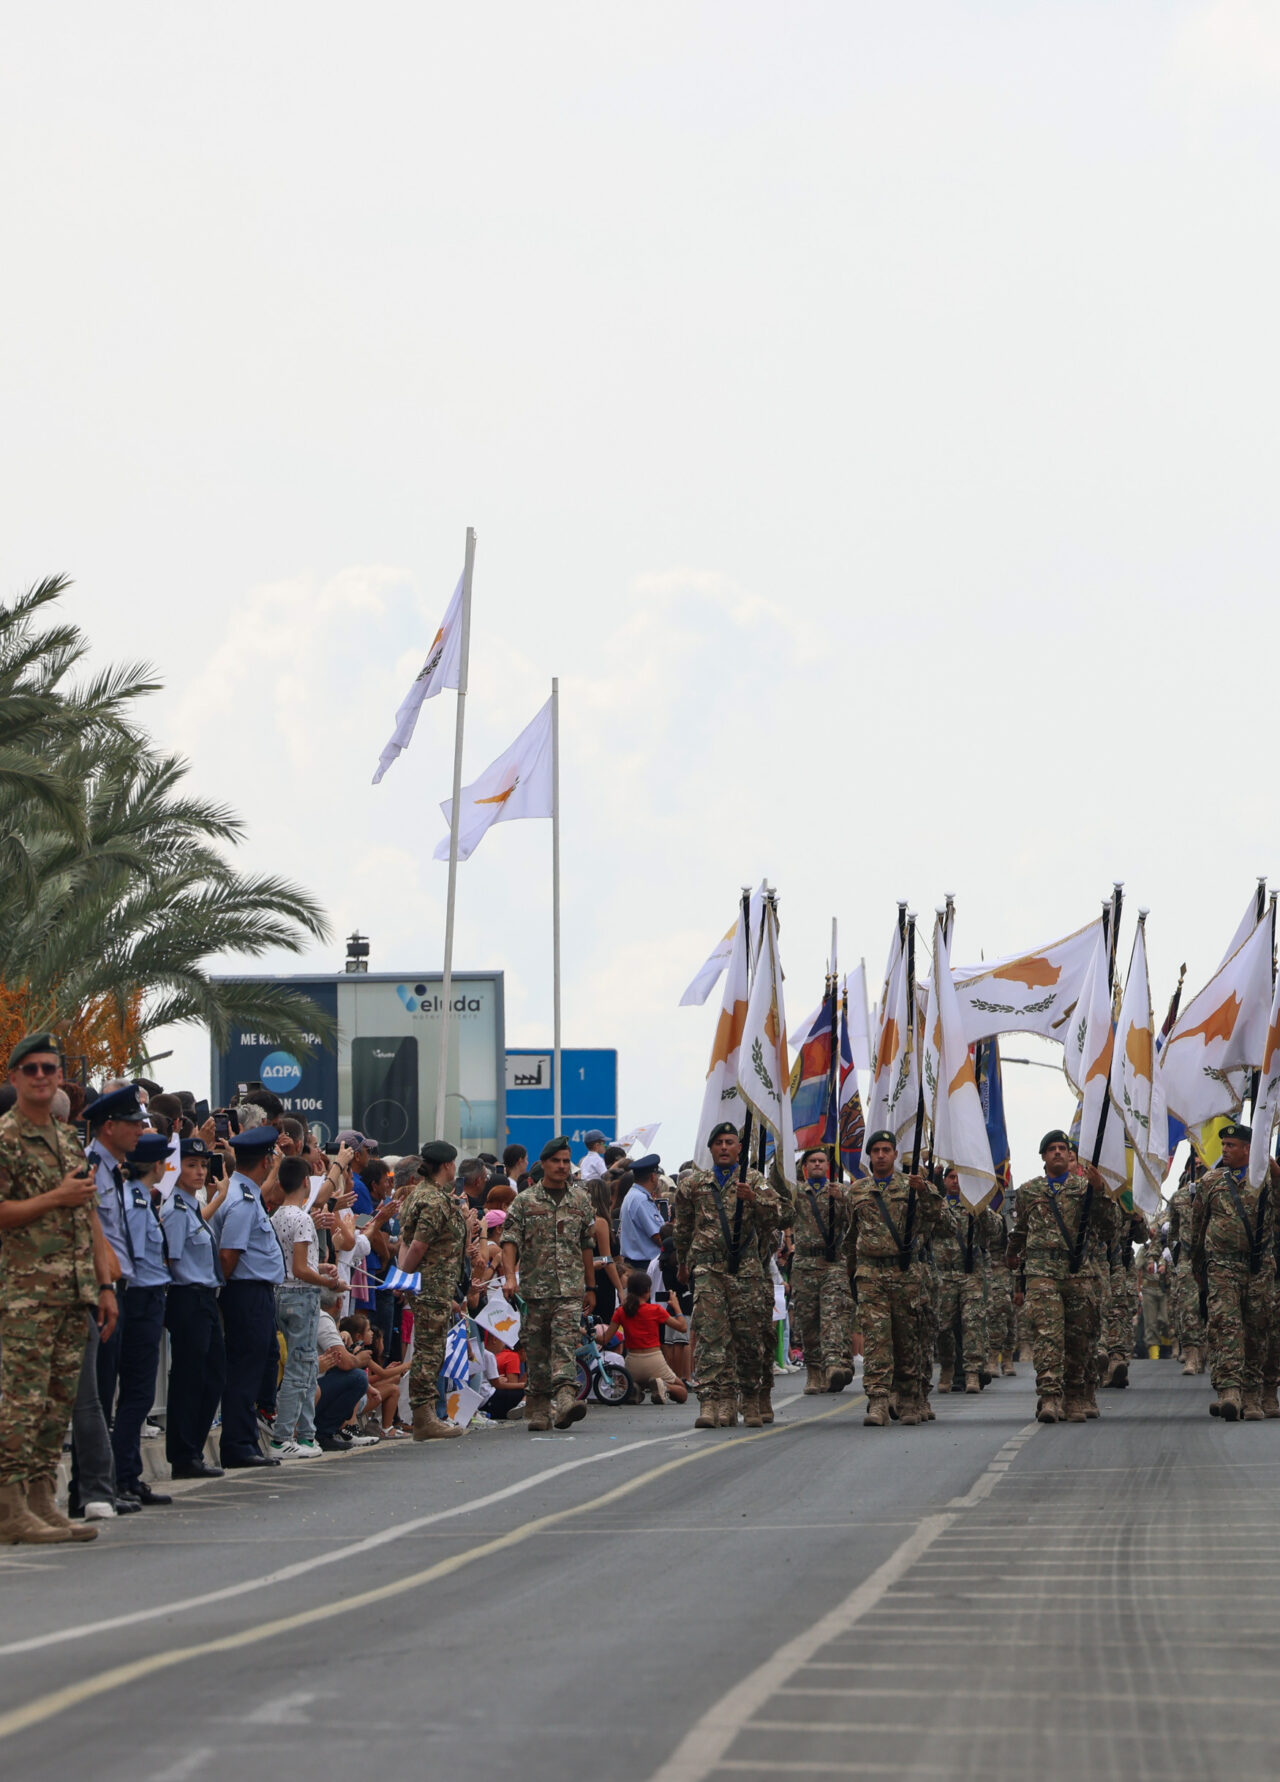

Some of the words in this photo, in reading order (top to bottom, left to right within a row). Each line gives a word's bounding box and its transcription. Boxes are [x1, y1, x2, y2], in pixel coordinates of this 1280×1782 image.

[262, 1065, 301, 1078] ΔΩΡΑ
[579, 1067, 585, 1081] 1
[294, 1098, 323, 1111] 100€
